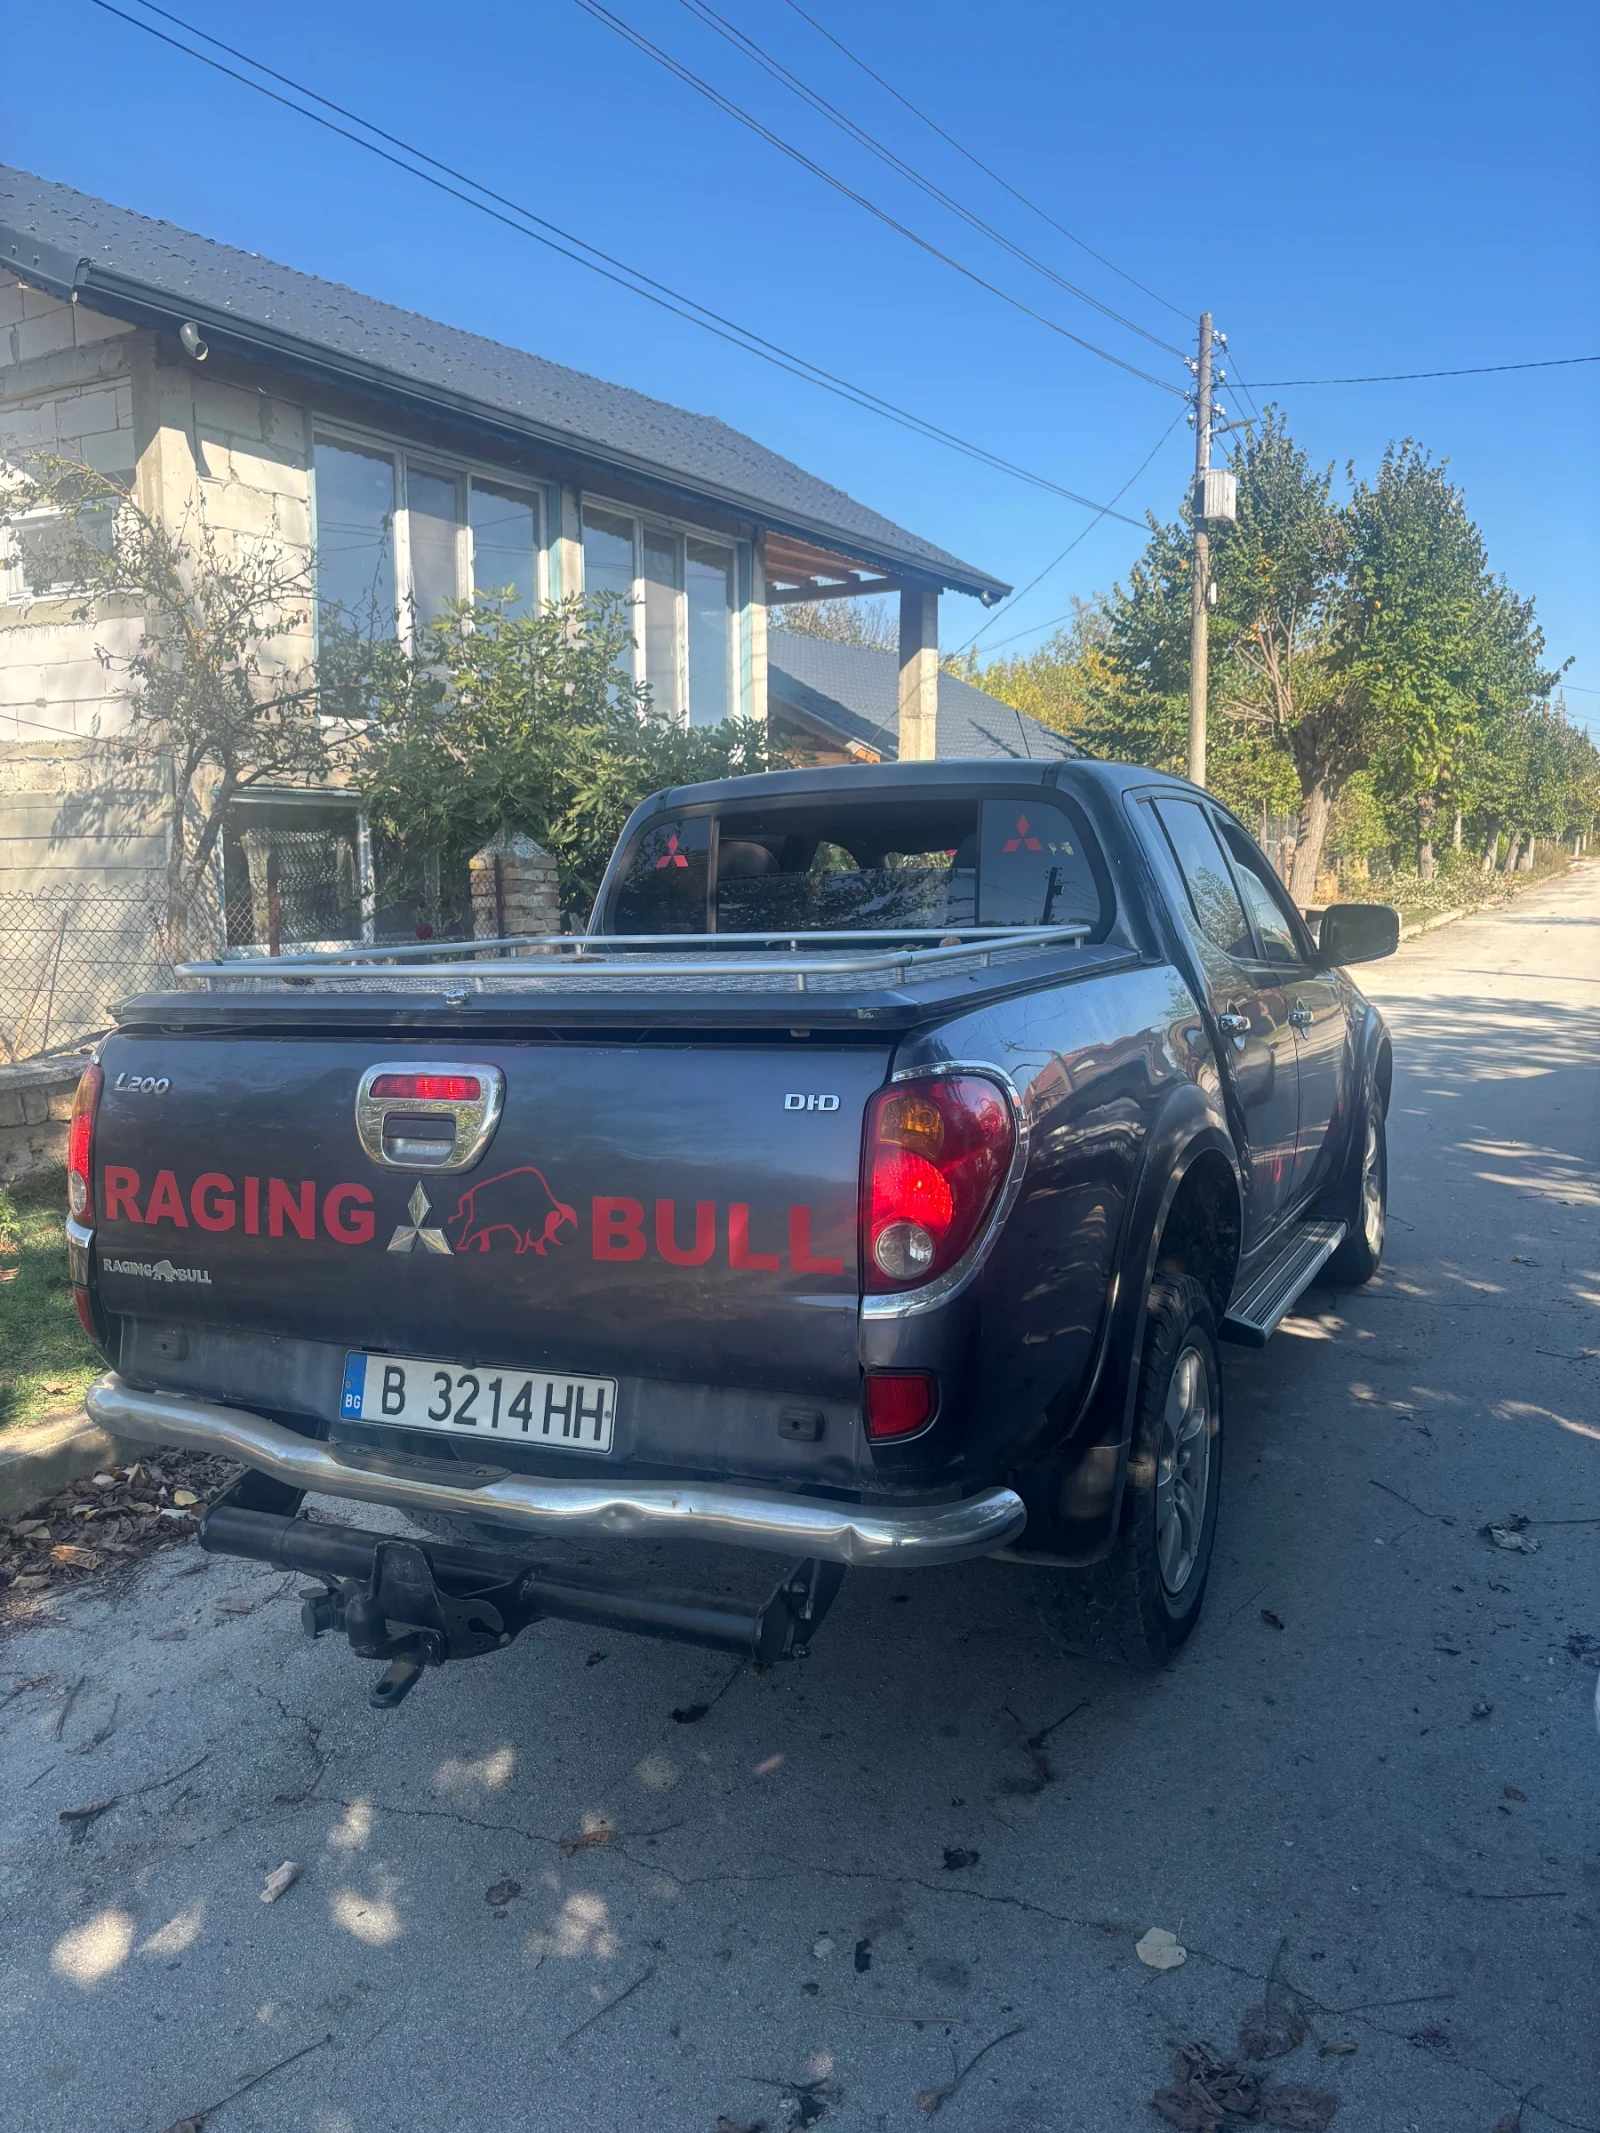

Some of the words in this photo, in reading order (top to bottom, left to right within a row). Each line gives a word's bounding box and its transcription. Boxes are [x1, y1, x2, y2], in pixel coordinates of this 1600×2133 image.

[114, 1072, 169, 1095] L200
[104, 1165, 375, 1245] RAGING
[591, 1195, 845, 1276] BULL
[103, 1258, 152, 1277] RAGING
[177, 1268, 213, 1284] BULL
[345, 1393, 361, 1410] BG
[381, 1365, 406, 1416] B
